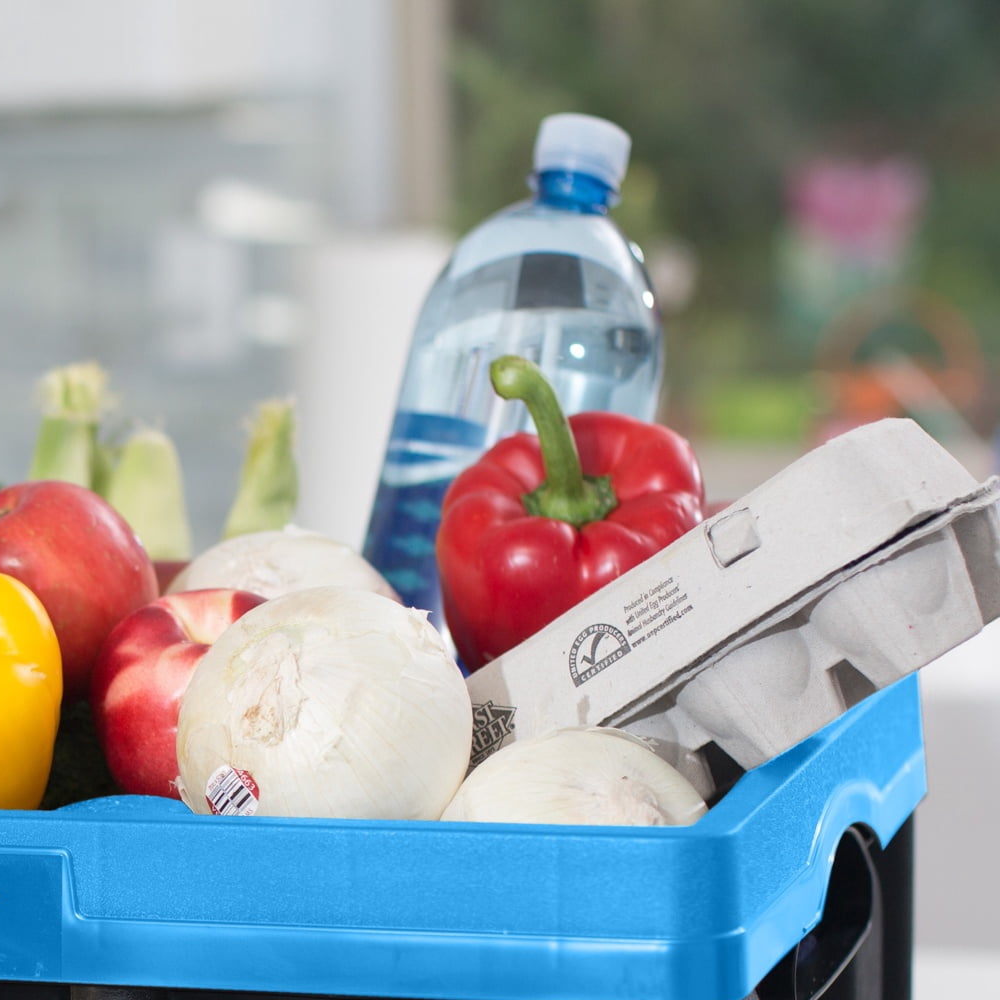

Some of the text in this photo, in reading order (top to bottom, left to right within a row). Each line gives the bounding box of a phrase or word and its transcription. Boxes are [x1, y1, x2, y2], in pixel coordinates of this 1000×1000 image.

[649, 599, 659, 610] Egg
[570, 625, 627, 679] UNITED EGG PRODUCERS
[580, 650, 623, 682] CERTIFIED
[237, 769, 256, 791] 4663
